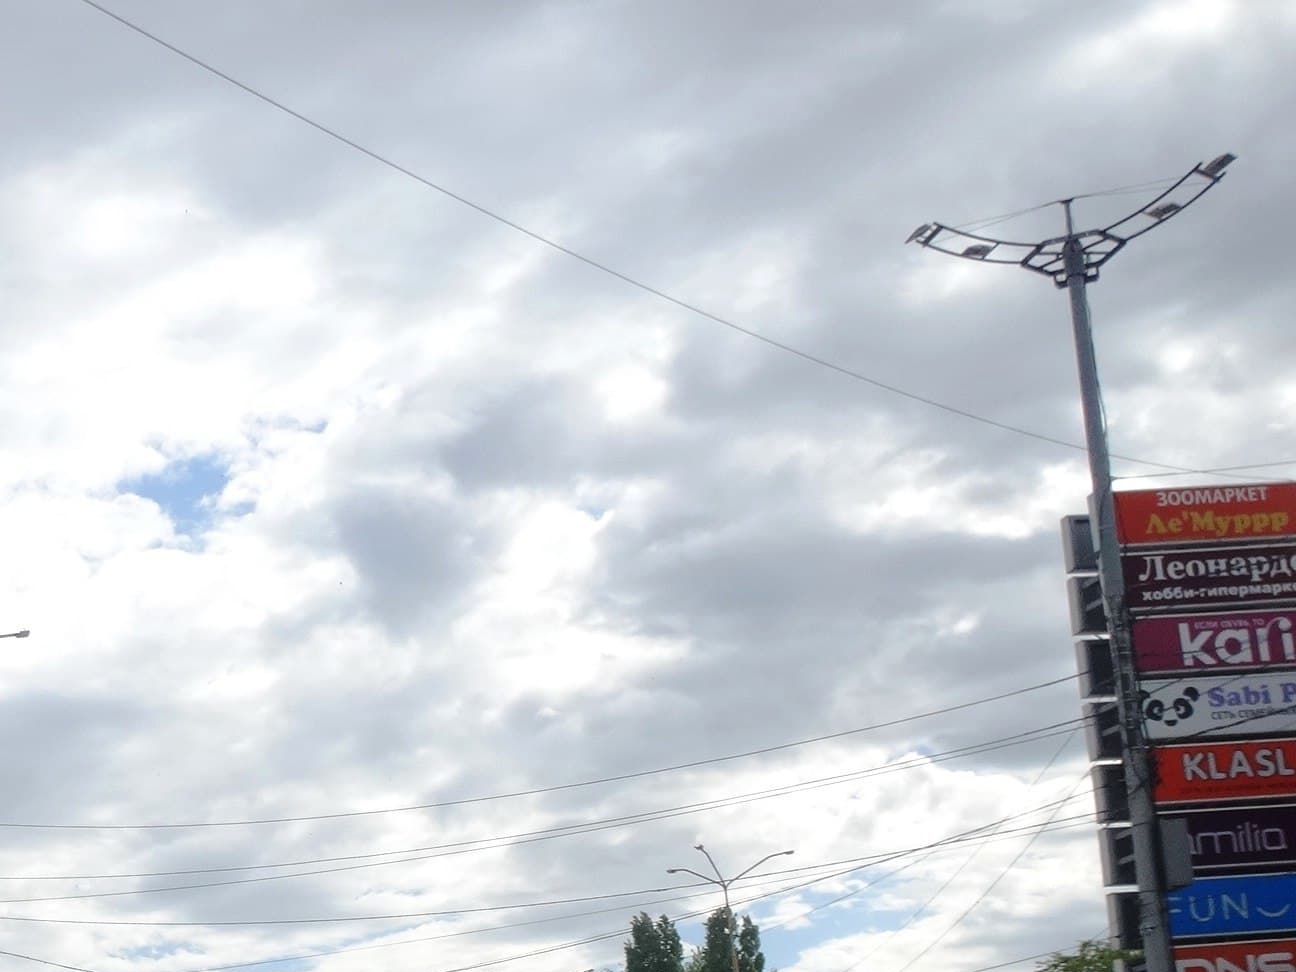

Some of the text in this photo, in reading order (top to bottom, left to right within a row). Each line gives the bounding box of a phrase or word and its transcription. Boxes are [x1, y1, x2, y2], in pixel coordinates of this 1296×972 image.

[1156, 487, 1268, 507] ЗООМАРКЕТ
[1178, 616, 1296, 667] kari
[1208, 684, 1271, 707] Sabi
[1182, 749, 1296, 782] KLASL
[1186, 821, 1288, 855] milia
